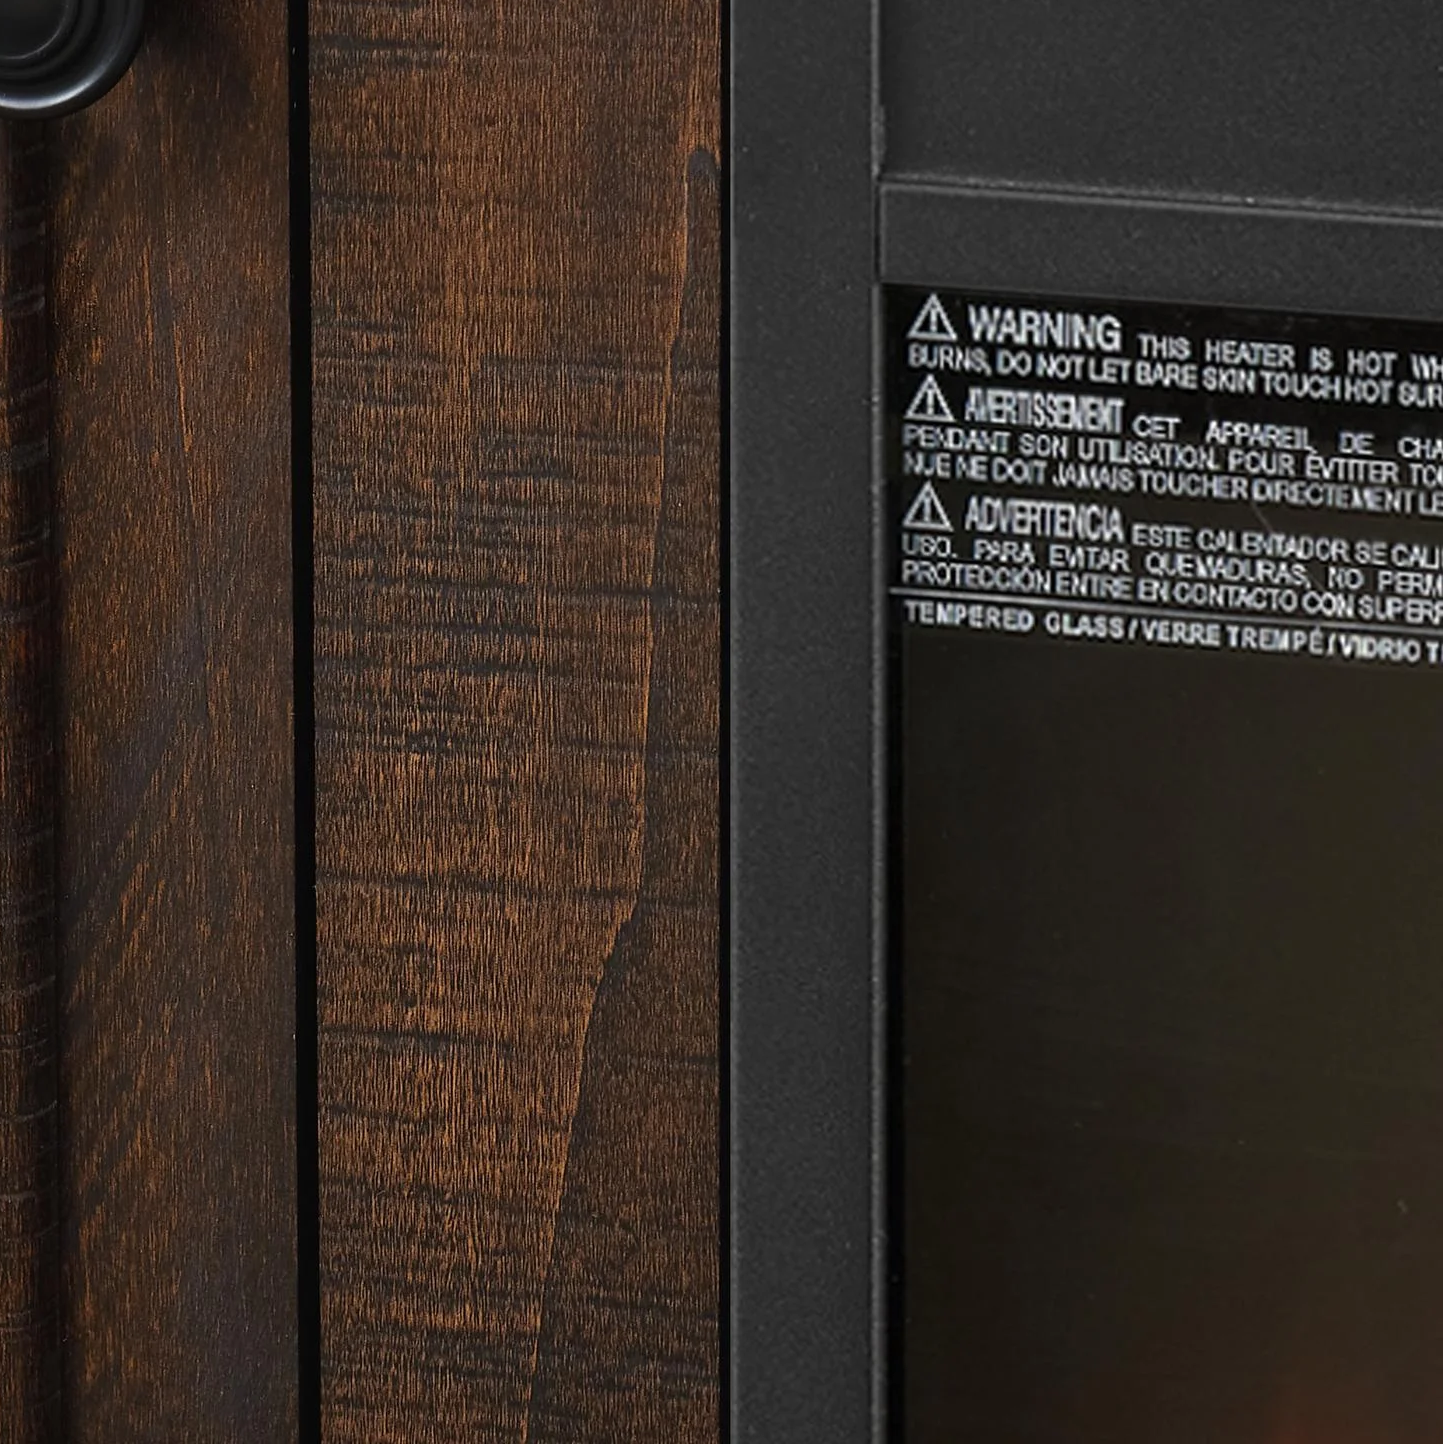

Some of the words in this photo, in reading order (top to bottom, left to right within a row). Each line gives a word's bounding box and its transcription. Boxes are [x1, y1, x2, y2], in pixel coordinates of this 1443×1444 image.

[969, 305, 1121, 352] WARNING
[1137, 333, 1191, 360] THIS
[1205, 338, 1295, 368] HEATER
[1310, 347, 1334, 372] IS
[1348, 350, 1397, 376] HOT
[997, 350, 1031, 375] DO
[1036, 353, 1084, 380] NOT
[1088, 357, 1132, 383] LET
[1135, 360, 1198, 390] BARE
[1203, 367, 1255, 394] SKIN
[1259, 370, 1340, 400] TOUCH
[1344, 377, 1393, 404] HOT
[904, 424, 1011, 453] PENDANT
[1018, 433, 1067, 458] SON
[1228, 448, 1295, 477] POUR
[1132, 415, 1181, 440] CET
[1339, 431, 1374, 455] DE
[955, 455, 988, 482] NE
[992, 456, 1047, 485] DOIT
[1138, 469, 1248, 500] TOUCHER
[965, 496, 1125, 543] ADVERTENCIA
[1132, 523, 1193, 549] ESTE
[1196, 528, 1350, 563] CALENTADOR
[1354, 540, 1387, 566] SE
[1391, 542, 1443, 569] CALI
[1056, 571, 1134, 600] ENTRE
[1138, 577, 1170, 603] EN
[1172, 581, 1297, 612] CONTACTO
[1302, 591, 1354, 617] CON
[1329, 566, 1364, 590] NO
[905, 600, 1035, 631] TEMPERED
